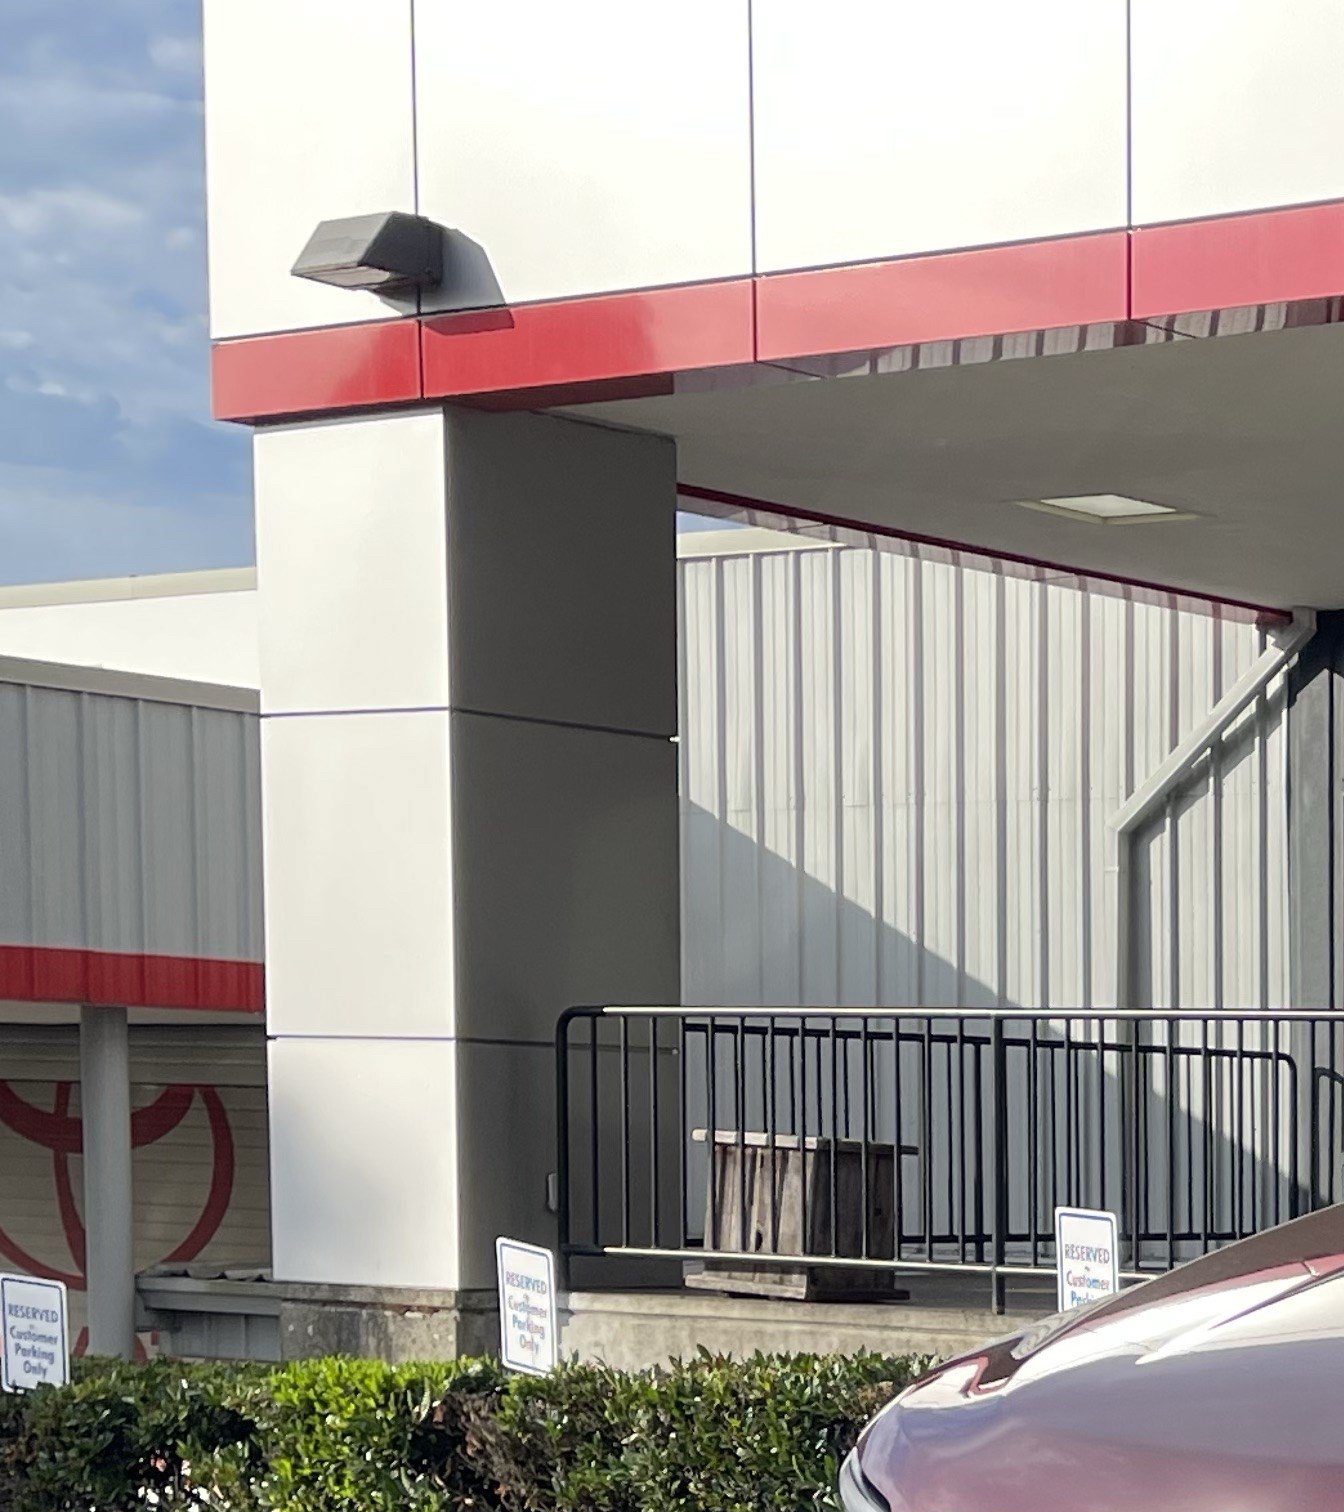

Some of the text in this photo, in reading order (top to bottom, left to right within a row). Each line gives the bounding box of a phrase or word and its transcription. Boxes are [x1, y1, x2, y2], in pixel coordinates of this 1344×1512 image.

[1065, 1243, 1110, 1264] RESERVED
[505, 1271, 547, 1295] RESERVED
[1066, 1270, 1109, 1291] Customer
[8, 1304, 59, 1323] RESERVED
[508, 1296, 547, 1318] Customer
[10, 1325, 58, 1345] Customer
[512, 1314, 545, 1340] Parking
[15, 1343, 55, 1365] Parking
[519, 1334, 539, 1354] Only
[23, 1361, 47, 1379] Only
